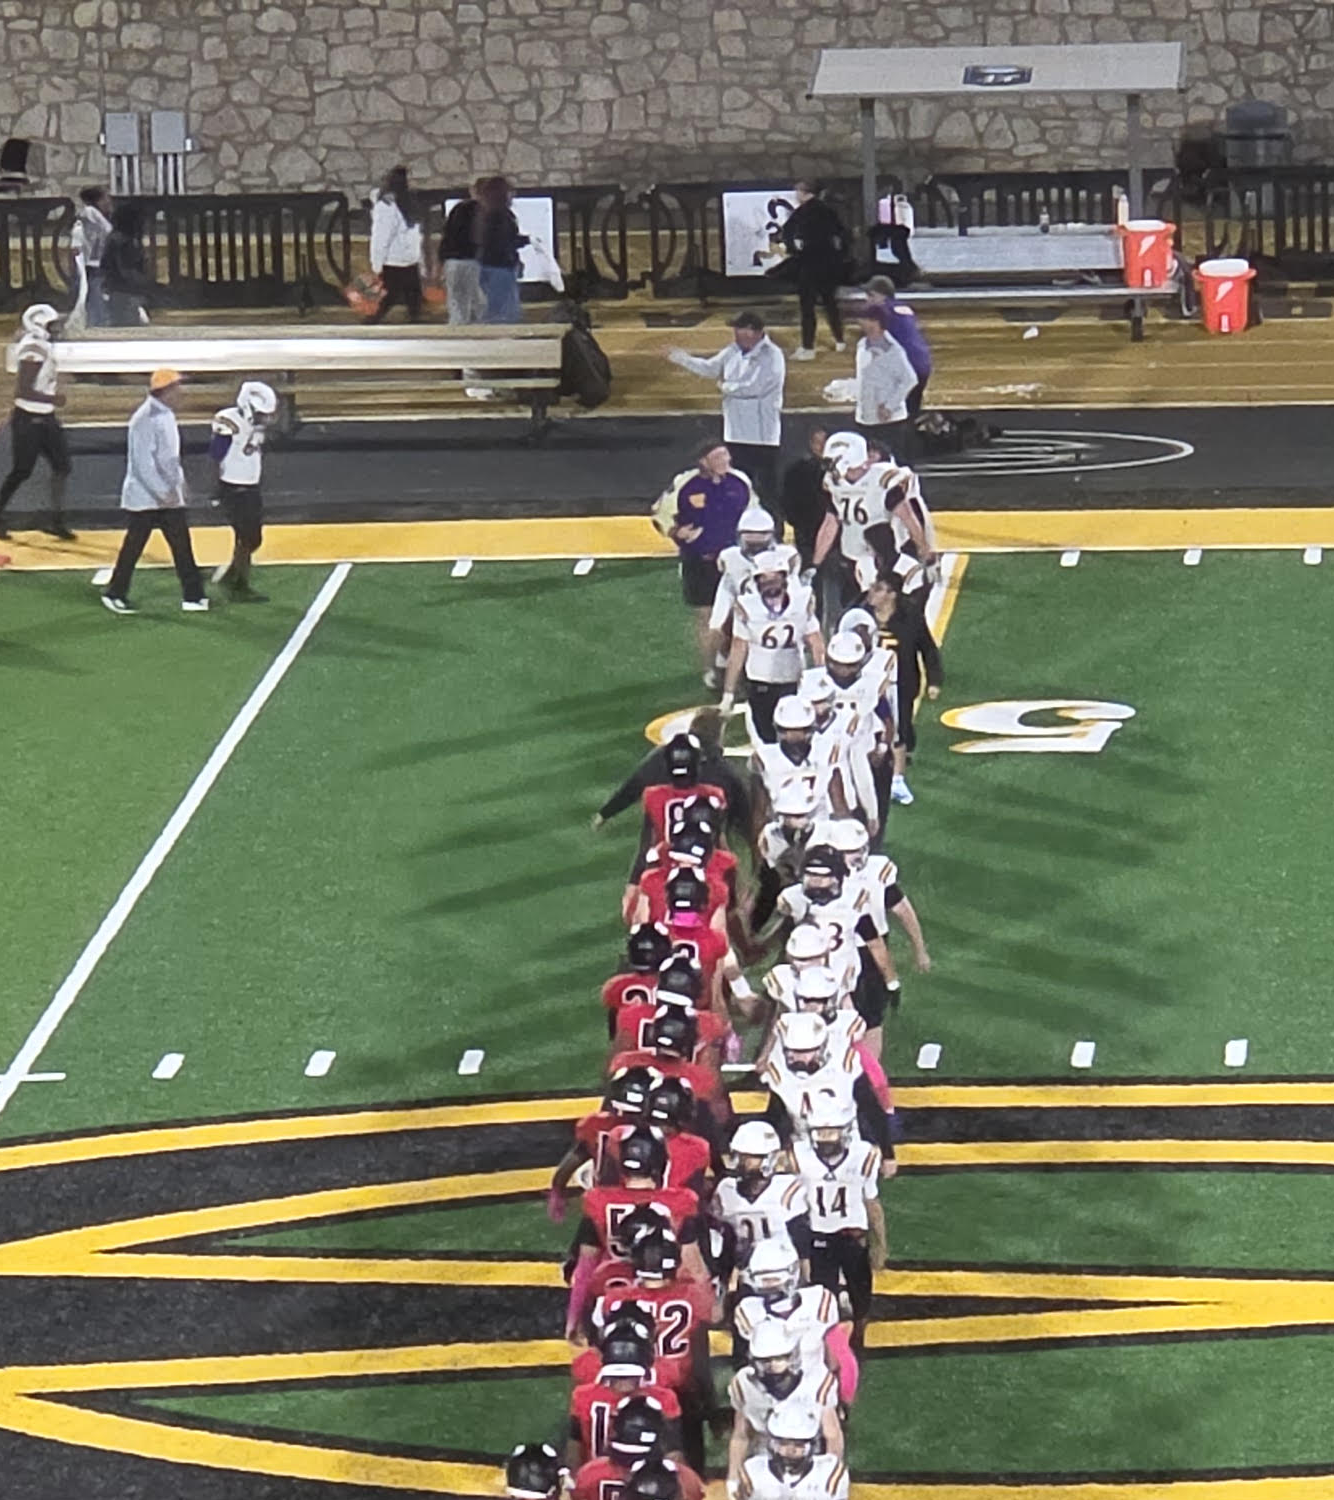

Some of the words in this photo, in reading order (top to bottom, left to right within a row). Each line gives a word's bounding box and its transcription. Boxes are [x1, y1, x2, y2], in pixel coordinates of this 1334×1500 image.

[840, 498, 868, 525] 76
[761, 624, 796, 649] 62
[816, 1186, 847, 1217] 14
